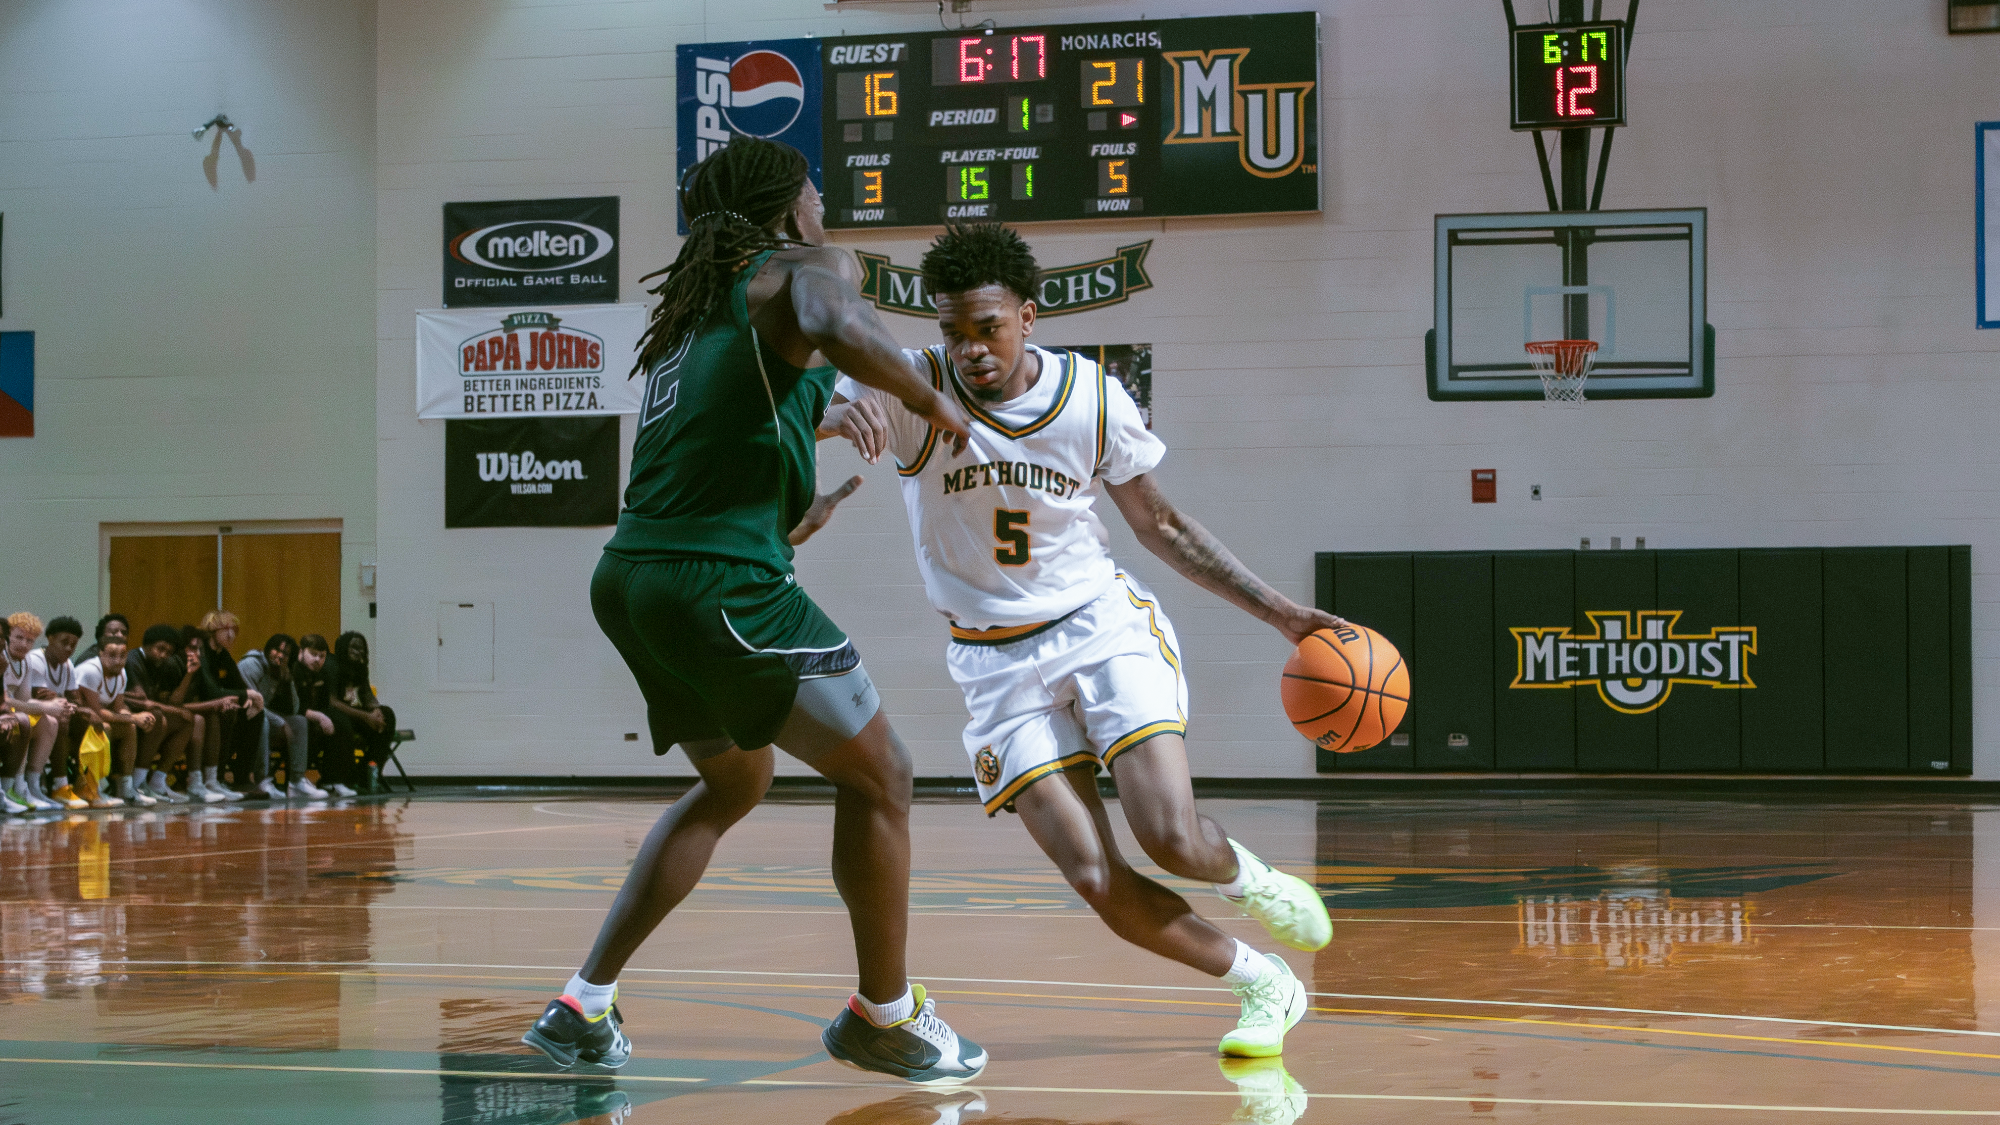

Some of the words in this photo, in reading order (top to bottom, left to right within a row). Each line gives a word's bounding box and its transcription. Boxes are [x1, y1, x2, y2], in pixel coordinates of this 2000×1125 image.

[830, 43, 905, 65] GUEST
[1061, 31, 1158, 50] MONARCHS
[1543, 31, 1607, 63] 6:17
[960, 35, 1045, 82] 6:17
[865, 72, 898, 116] 16
[1092, 60, 1143, 105] 21
[1556, 65, 1597, 116] 12
[930, 108, 997, 127] PERIOD
[1021, 98, 1029, 131] 1
[1162, 48, 1315, 179] MU
[846, 154, 891, 168] FOULS
[941, 147, 1040, 163] PLAYER-FOUL
[1091, 142, 1137, 157] FOULS
[960, 167, 989, 200] 15
[1025, 164, 1033, 198] 1
[1108, 160, 1128, 194] 5
[1301, 164, 1317, 174] TM
[863, 171, 883, 204] 3
[852, 209, 885, 222] WON
[947, 204, 990, 218] GAME
[1097, 199, 1131, 212] WON
[488, 230, 585, 259] molten
[455, 277, 517, 288] OFFICIAL
[523, 276, 564, 286] GAME
[570, 274, 607, 285] BALL
[512, 314, 550, 325] PIZZA
[463, 333, 522, 372] PAPA
[464, 378, 511, 392] BETTER
[464, 393, 536, 413] BETTER
[542, 391, 605, 411] PIZZA.
[476, 450, 584, 482] Wilson
[943, 461, 1081, 501] METHODIST
[510, 483, 553, 494] WILSON.COM
[993, 507, 1032, 568] 5
[1525, 634, 1749, 682] METHODIST
